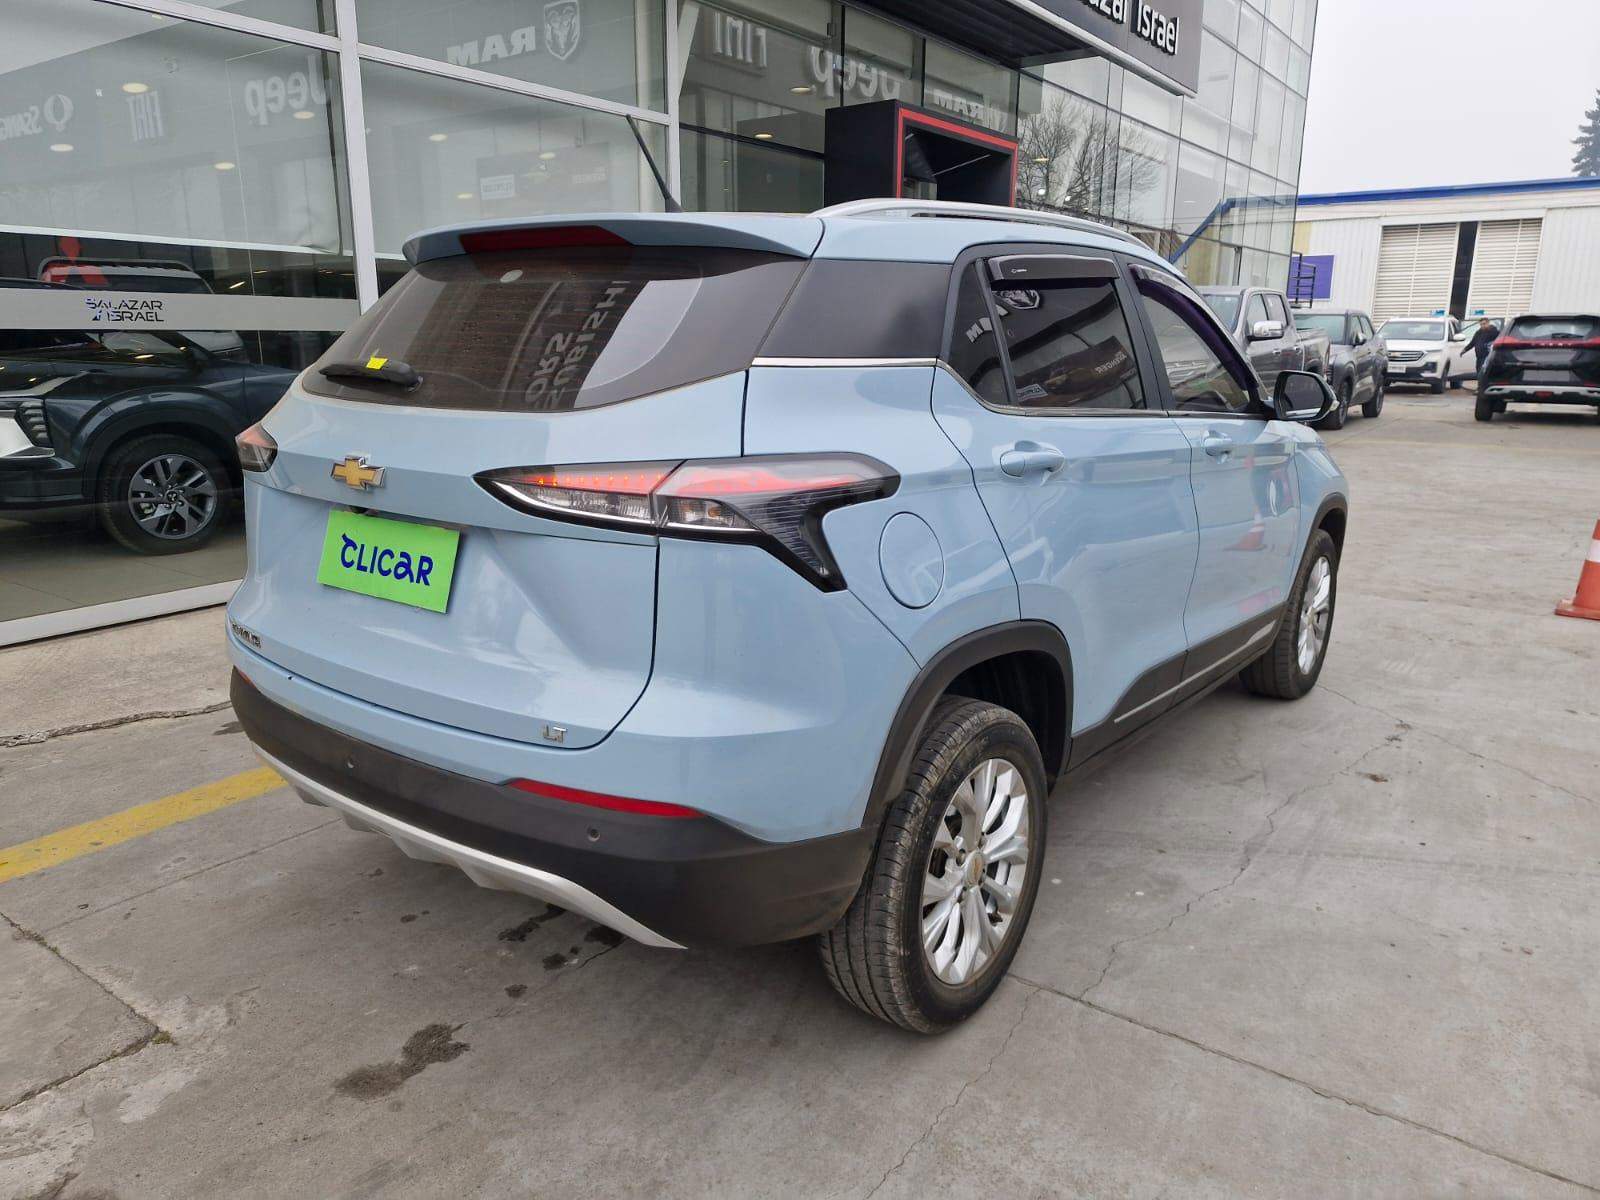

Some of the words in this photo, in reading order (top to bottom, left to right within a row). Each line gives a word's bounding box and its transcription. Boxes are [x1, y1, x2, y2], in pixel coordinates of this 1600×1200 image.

[1137, 0, 1179, 55] Israel
[86, 298, 162, 310] SALAZAR
[107, 310, 164, 322] ISRAEL
[543, 725, 567, 744] LT
